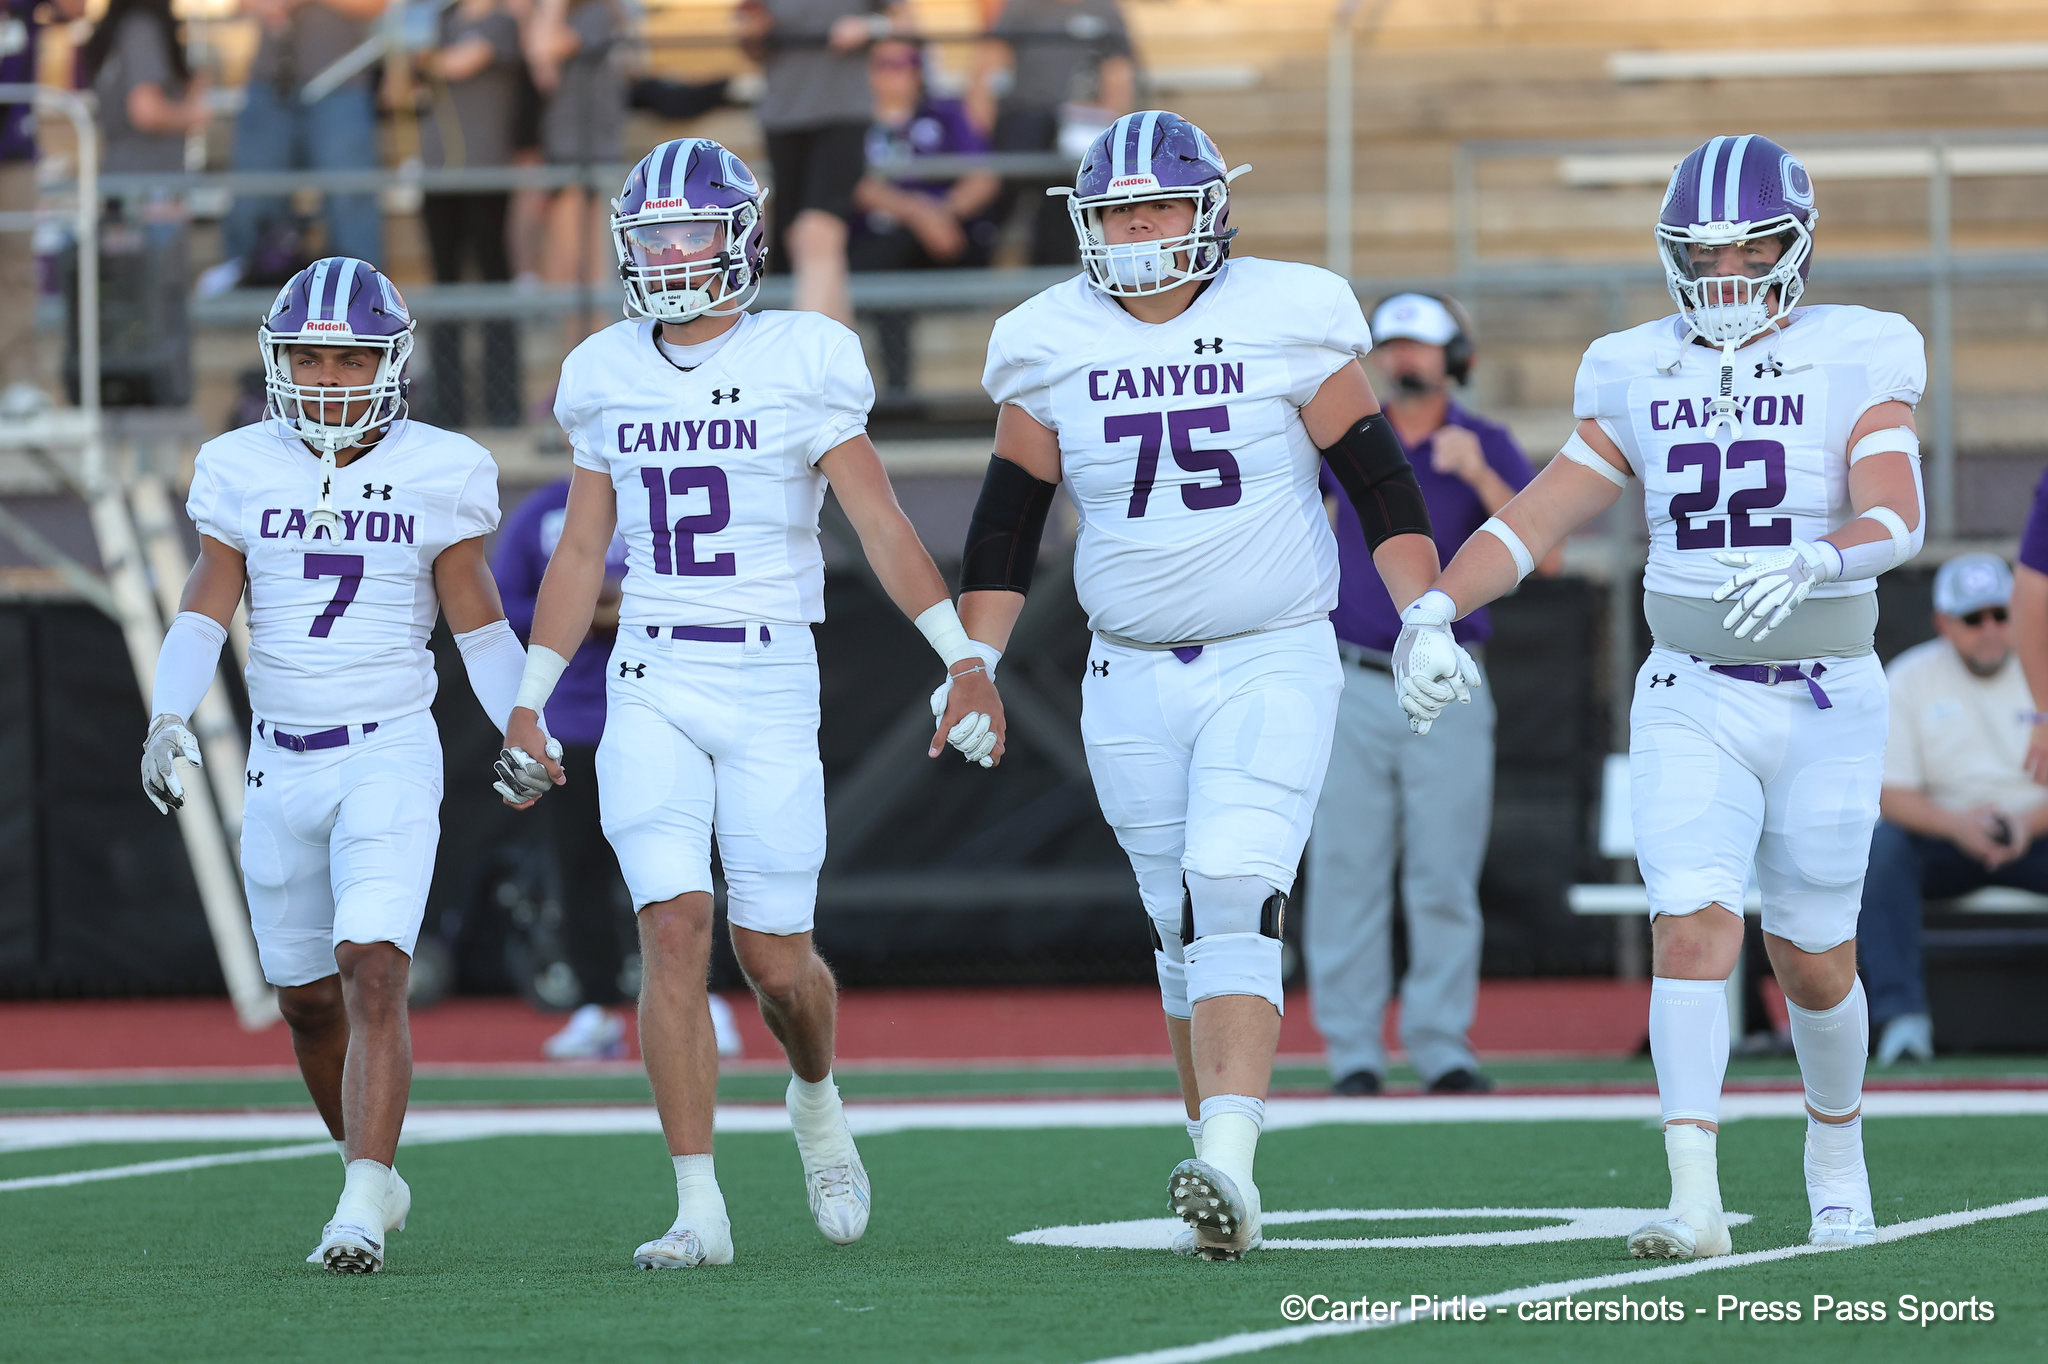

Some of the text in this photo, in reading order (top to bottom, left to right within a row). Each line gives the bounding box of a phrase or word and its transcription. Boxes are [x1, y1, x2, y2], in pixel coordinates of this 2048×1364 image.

[644, 198, 683, 210] Riddell
[1709, 223, 1730, 231] VICIS
[306, 321, 347, 332] Riddell
[1088, 362, 1244, 401] CANYON
[1719, 365, 1734, 397] NXTRND
[617, 419, 757, 454] CANYON
[1104, 405, 1242, 519] 75
[1667, 439, 1792, 550] 22
[260, 508, 415, 545] CAYON
[641, 465, 737, 577] 12
[303, 552, 365, 639] 7
